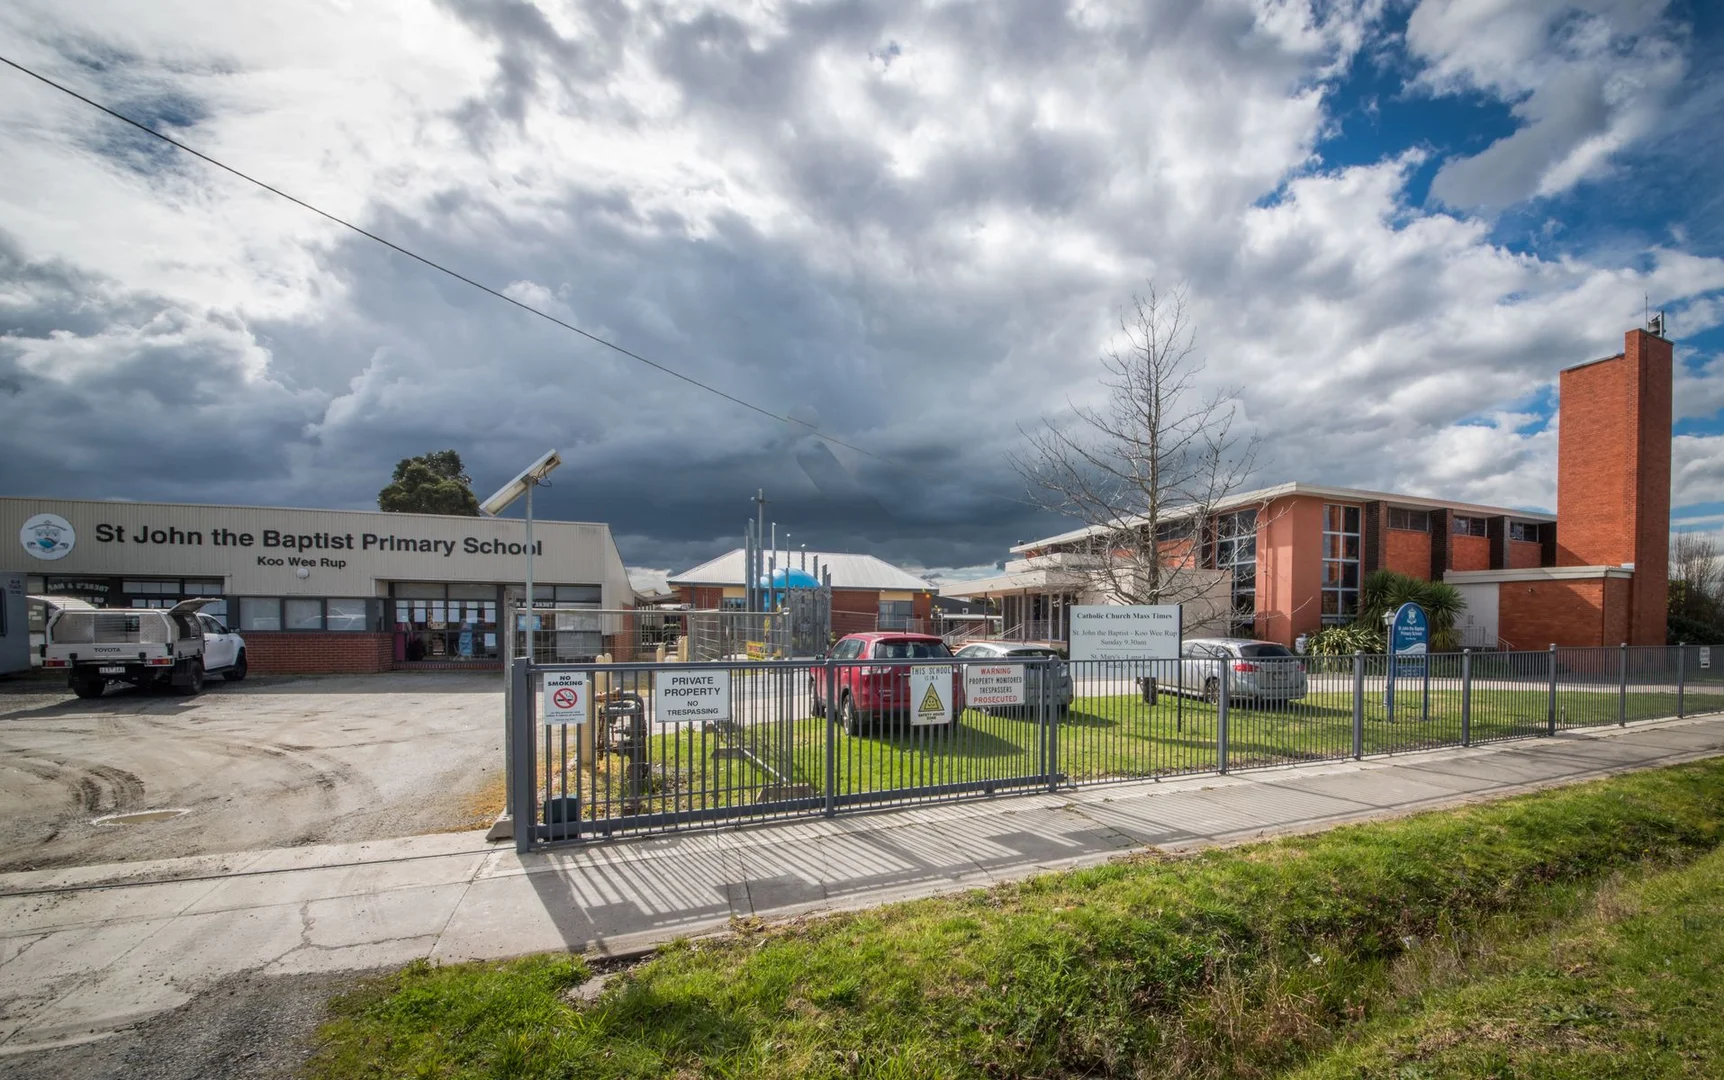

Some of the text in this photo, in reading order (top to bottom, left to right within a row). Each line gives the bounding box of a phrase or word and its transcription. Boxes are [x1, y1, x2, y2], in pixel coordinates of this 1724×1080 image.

[96, 524, 542, 557] St John the Baptist Primary School
[257, 556, 346, 569] Koo Wee Rup
[1164, 630, 1178, 638] Rup
[912, 666, 951, 675] THIS SCHOOL
[672, 676, 714, 686] PRIVATE
[969, 676, 1022, 685] PROPERTY MONITORED
[664, 687, 721, 697] PROPERTY
[980, 686, 1012, 694] TRESPASSERS
[974, 696, 1017, 704] PROSECUTED
[667, 708, 719, 716] TRESPASSING
